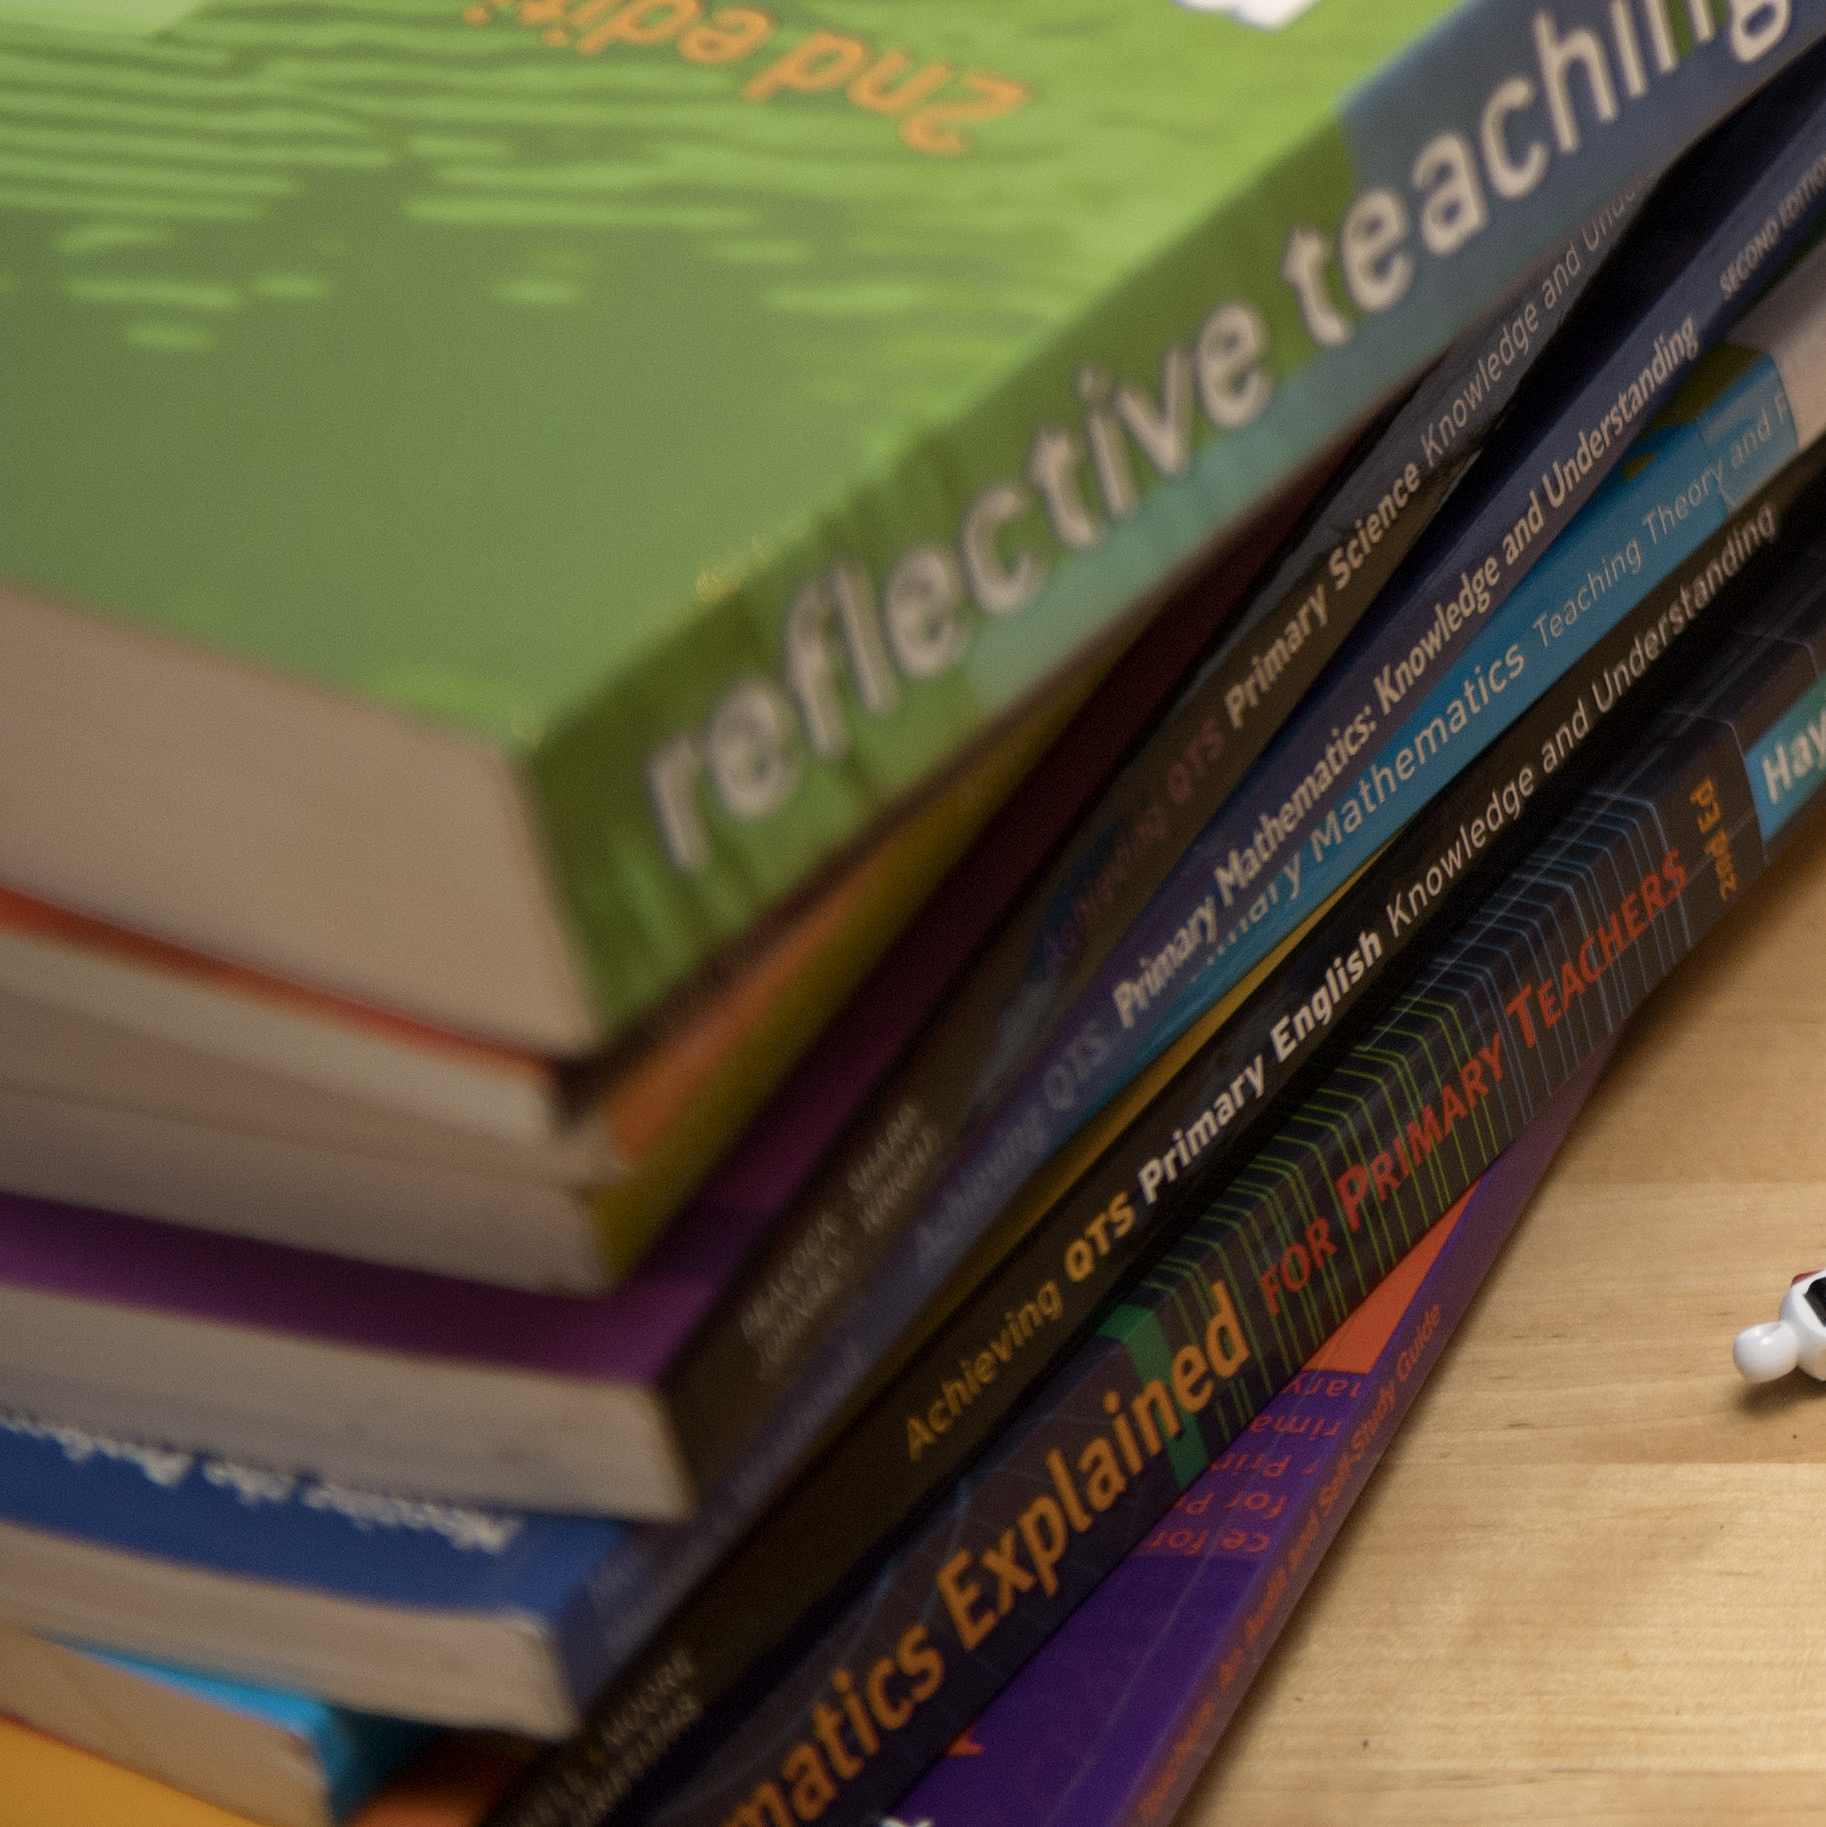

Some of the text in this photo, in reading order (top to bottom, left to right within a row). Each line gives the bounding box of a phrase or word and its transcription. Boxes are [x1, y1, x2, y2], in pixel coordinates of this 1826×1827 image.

[744, 25, 1031, 153] 2nd
[648, 299, 1276, 878] reflective
[1111, 889, 1220, 1030] Primary
[1212, 706, 1379, 906] Mathematics:
[1372, 556, 1501, 717] Knowledge
[1500, 489, 1546, 568] and
[1542, 313, 1699, 509] Understanding
[1717, 219, 1781, 302] SECOND
[1167, 717, 1228, 804] QTS
[1223, 585, 1330, 730] Primary
[1328, 464, 1422, 590] Science
[1418, 304, 1540, 470] Knowledge
[1542, 249, 1584, 326] and
[1309, 642, 1527, 868] Mathematics
[1532, 536, 1643, 650] Teaching
[1641, 456, 1727, 547] Theory
[1730, 417, 1774, 476] and
[905, 502, 1779, 1464] Achieving QTS Primary English Knowledge and Understanding
[1688, 779, 1738, 903] 2nd Ed
[937, 1279, 1251, 1651] Explained
[1257, 1216, 1340, 1318] FOR
[1335, 1032, 1506, 1234] PRIMARY
[1504, 844, 1691, 1050] TEACHERS
[1316, 1385, 1399, 1518] Self-Study
[1394, 1304, 1442, 1383] Guide
